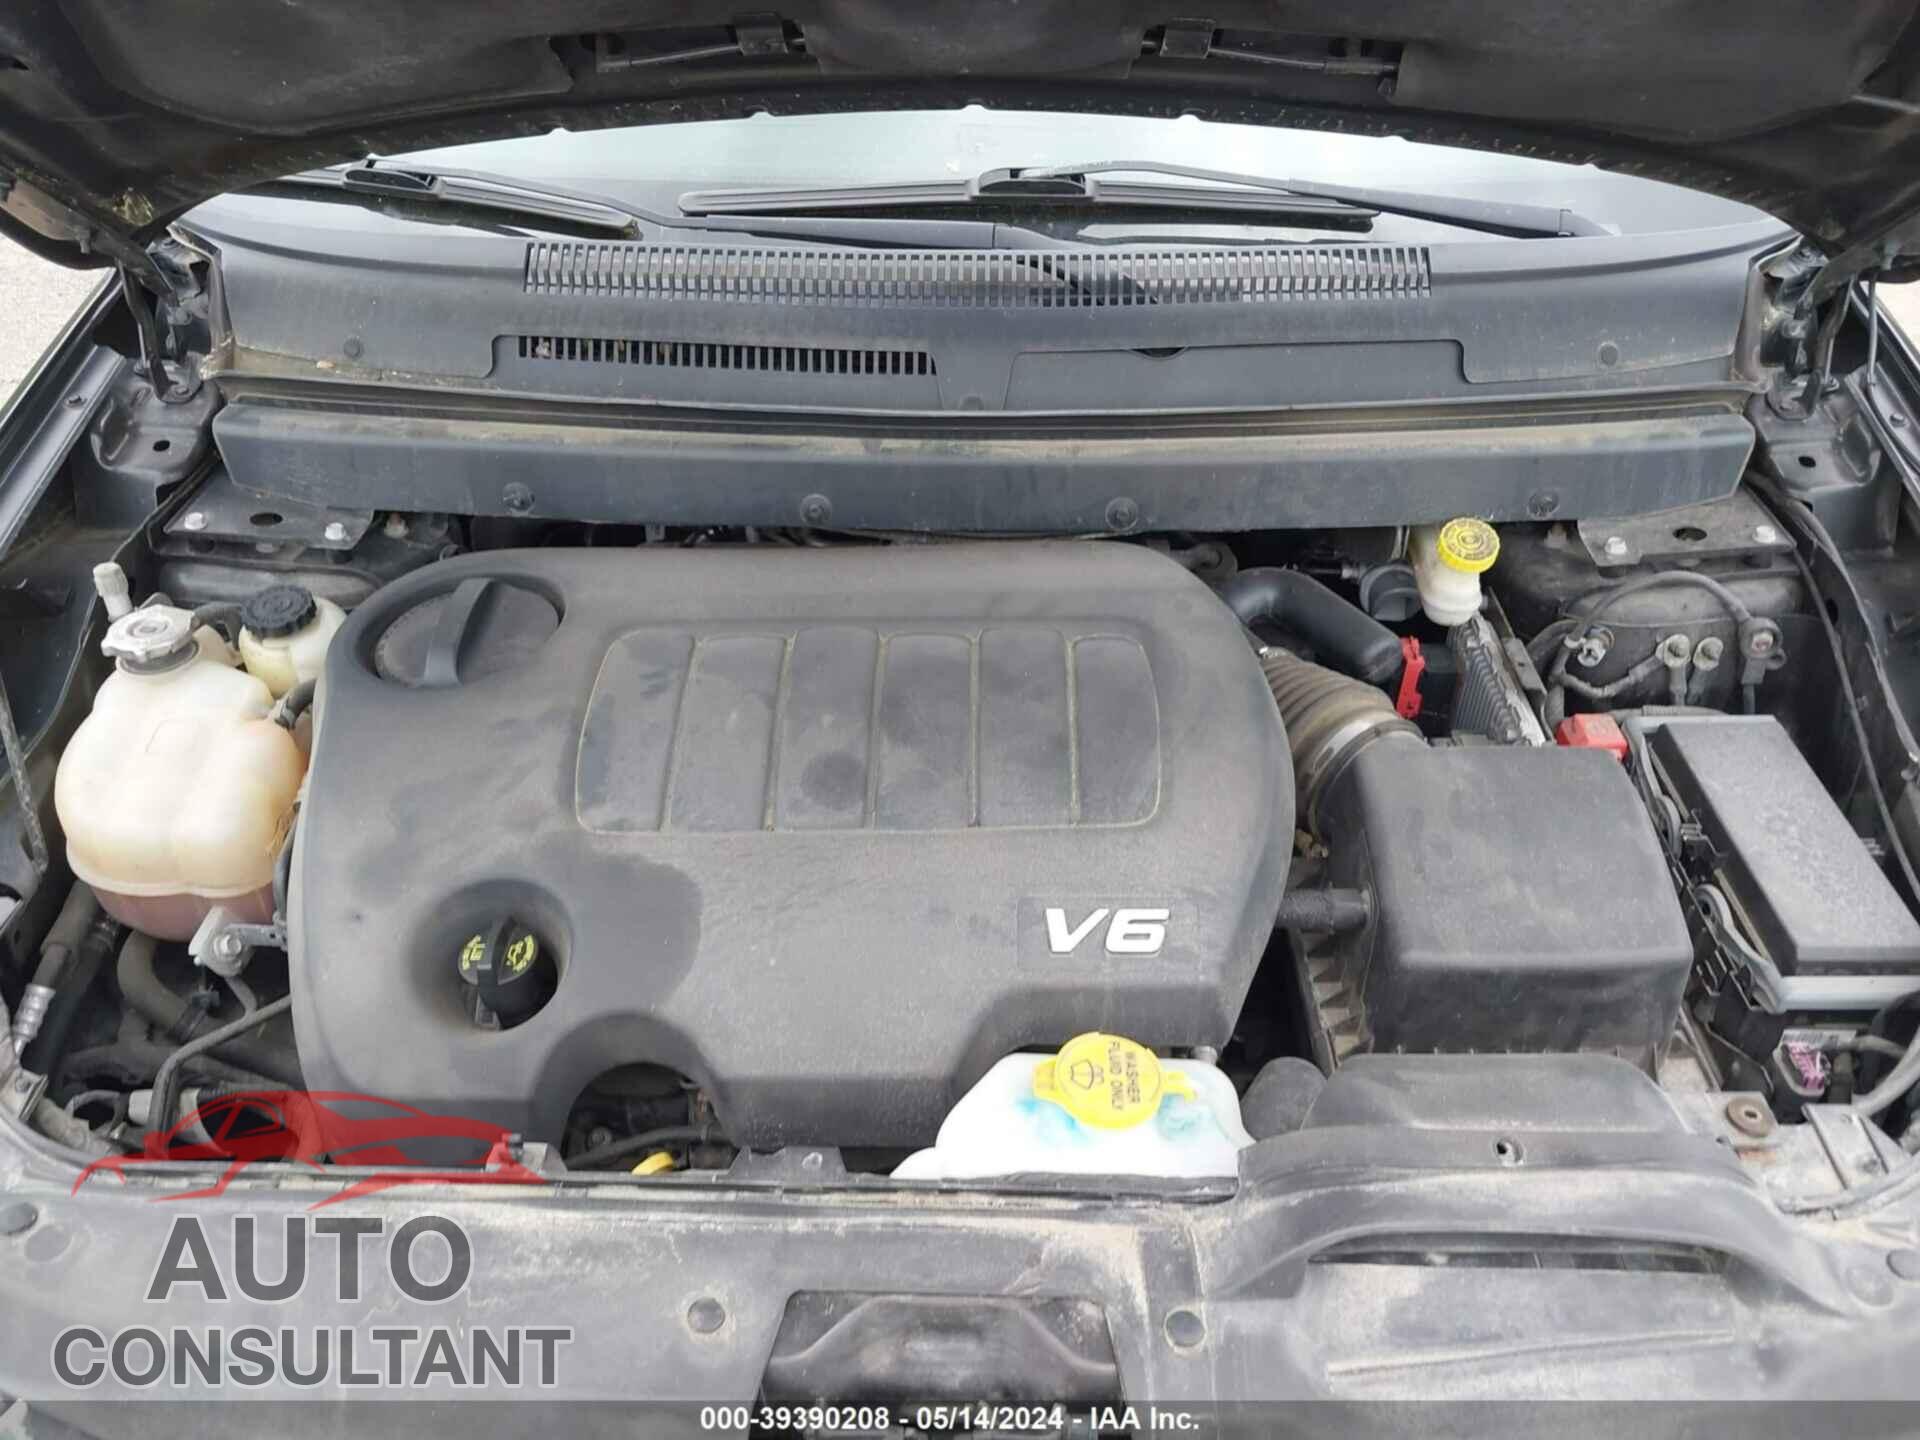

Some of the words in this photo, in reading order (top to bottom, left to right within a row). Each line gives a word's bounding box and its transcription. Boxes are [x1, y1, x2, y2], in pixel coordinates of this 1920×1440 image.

[1045, 907, 1170, 953] V6
[1108, 1040, 1122, 1075] FLUID
[1125, 1051, 1141, 1104] WASHER
[1110, 1080, 1124, 1111] ONLY
